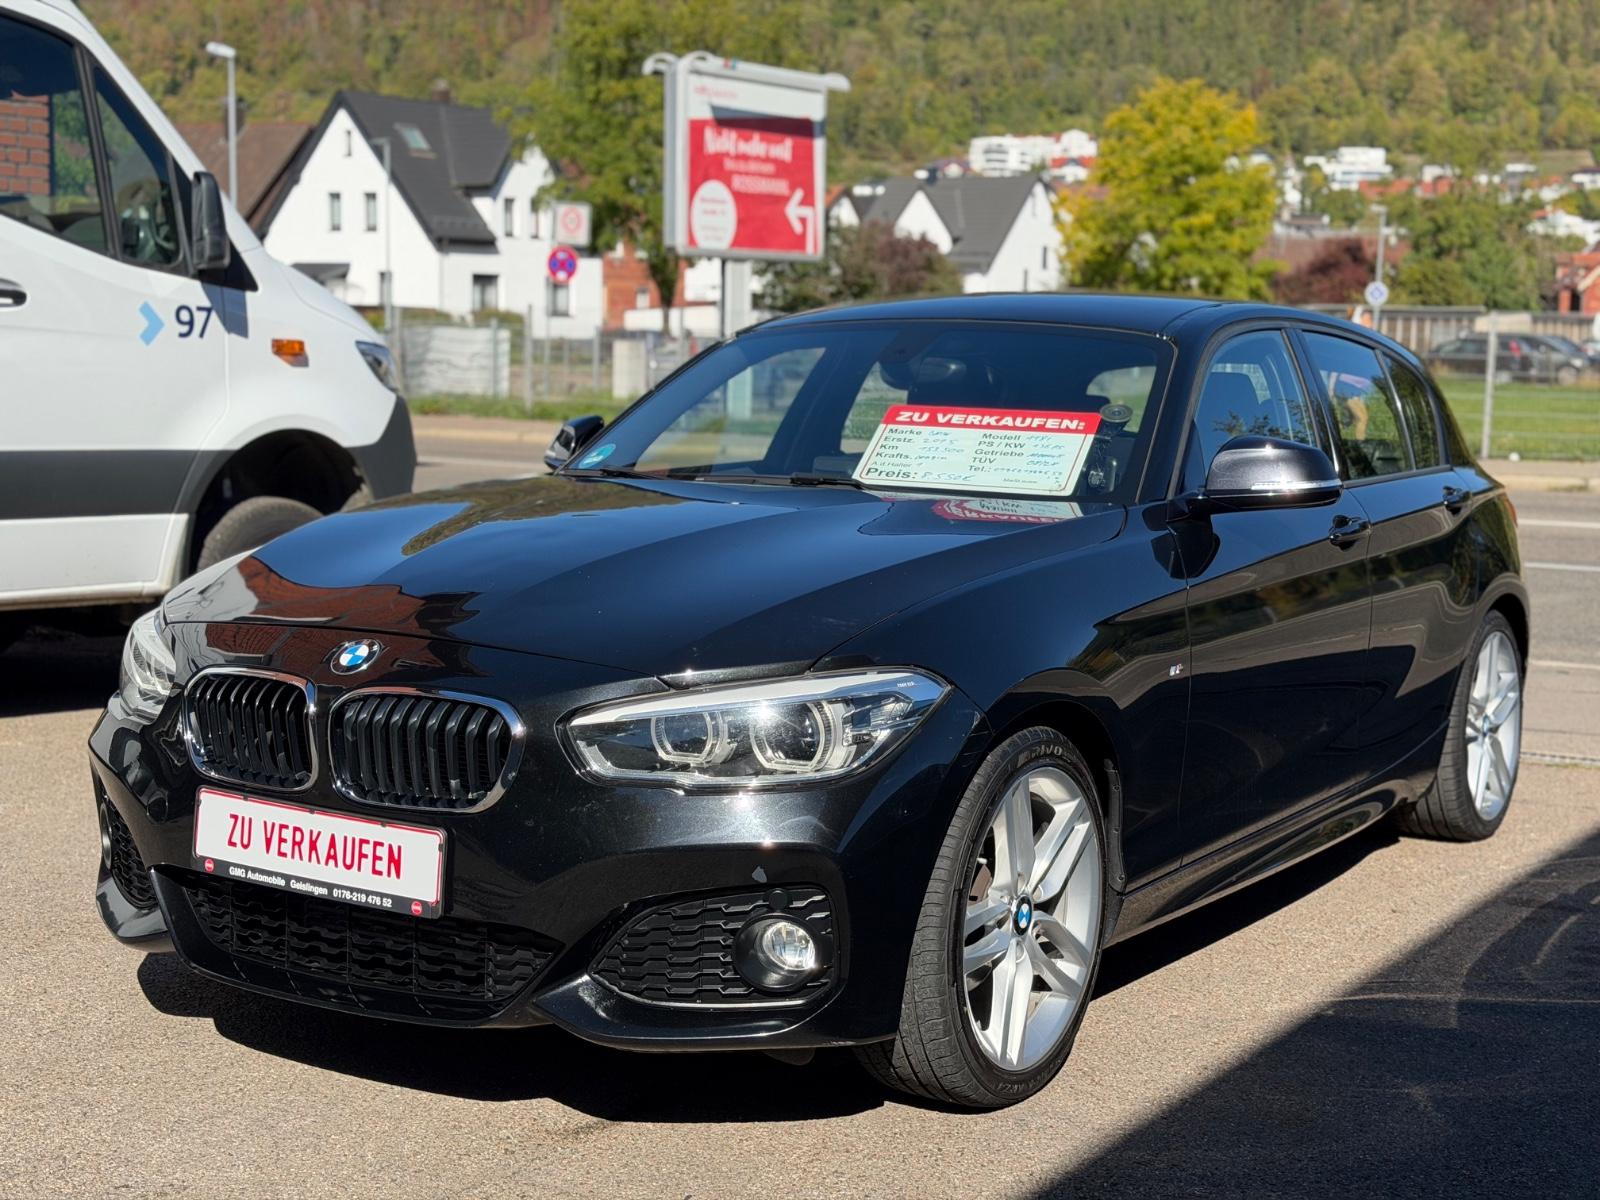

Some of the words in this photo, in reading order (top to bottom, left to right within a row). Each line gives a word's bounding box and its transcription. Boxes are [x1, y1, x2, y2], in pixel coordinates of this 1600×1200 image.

[175, 304, 213, 339] 97
[895, 411, 931, 422] ZU
[936, 412, 1086, 430] VERKAUFEN:
[888, 428, 922, 436] Marke
[982, 433, 1022, 441] Modell
[880, 443, 899, 451] Km
[978, 440, 995, 448] PS
[974, 449, 1024, 457] Getriebe
[972, 456, 996, 464] TÜV
[865, 467, 918, 479] Preis:
[227, 813, 253, 850] ZU
[263, 820, 403, 880] VERKAUFEN
[228, 866, 246, 878] GMG
[247, 870, 286, 887] Automobile
[290, 879, 328, 896] Geislingen
[382, 897, 393, 908] 52
